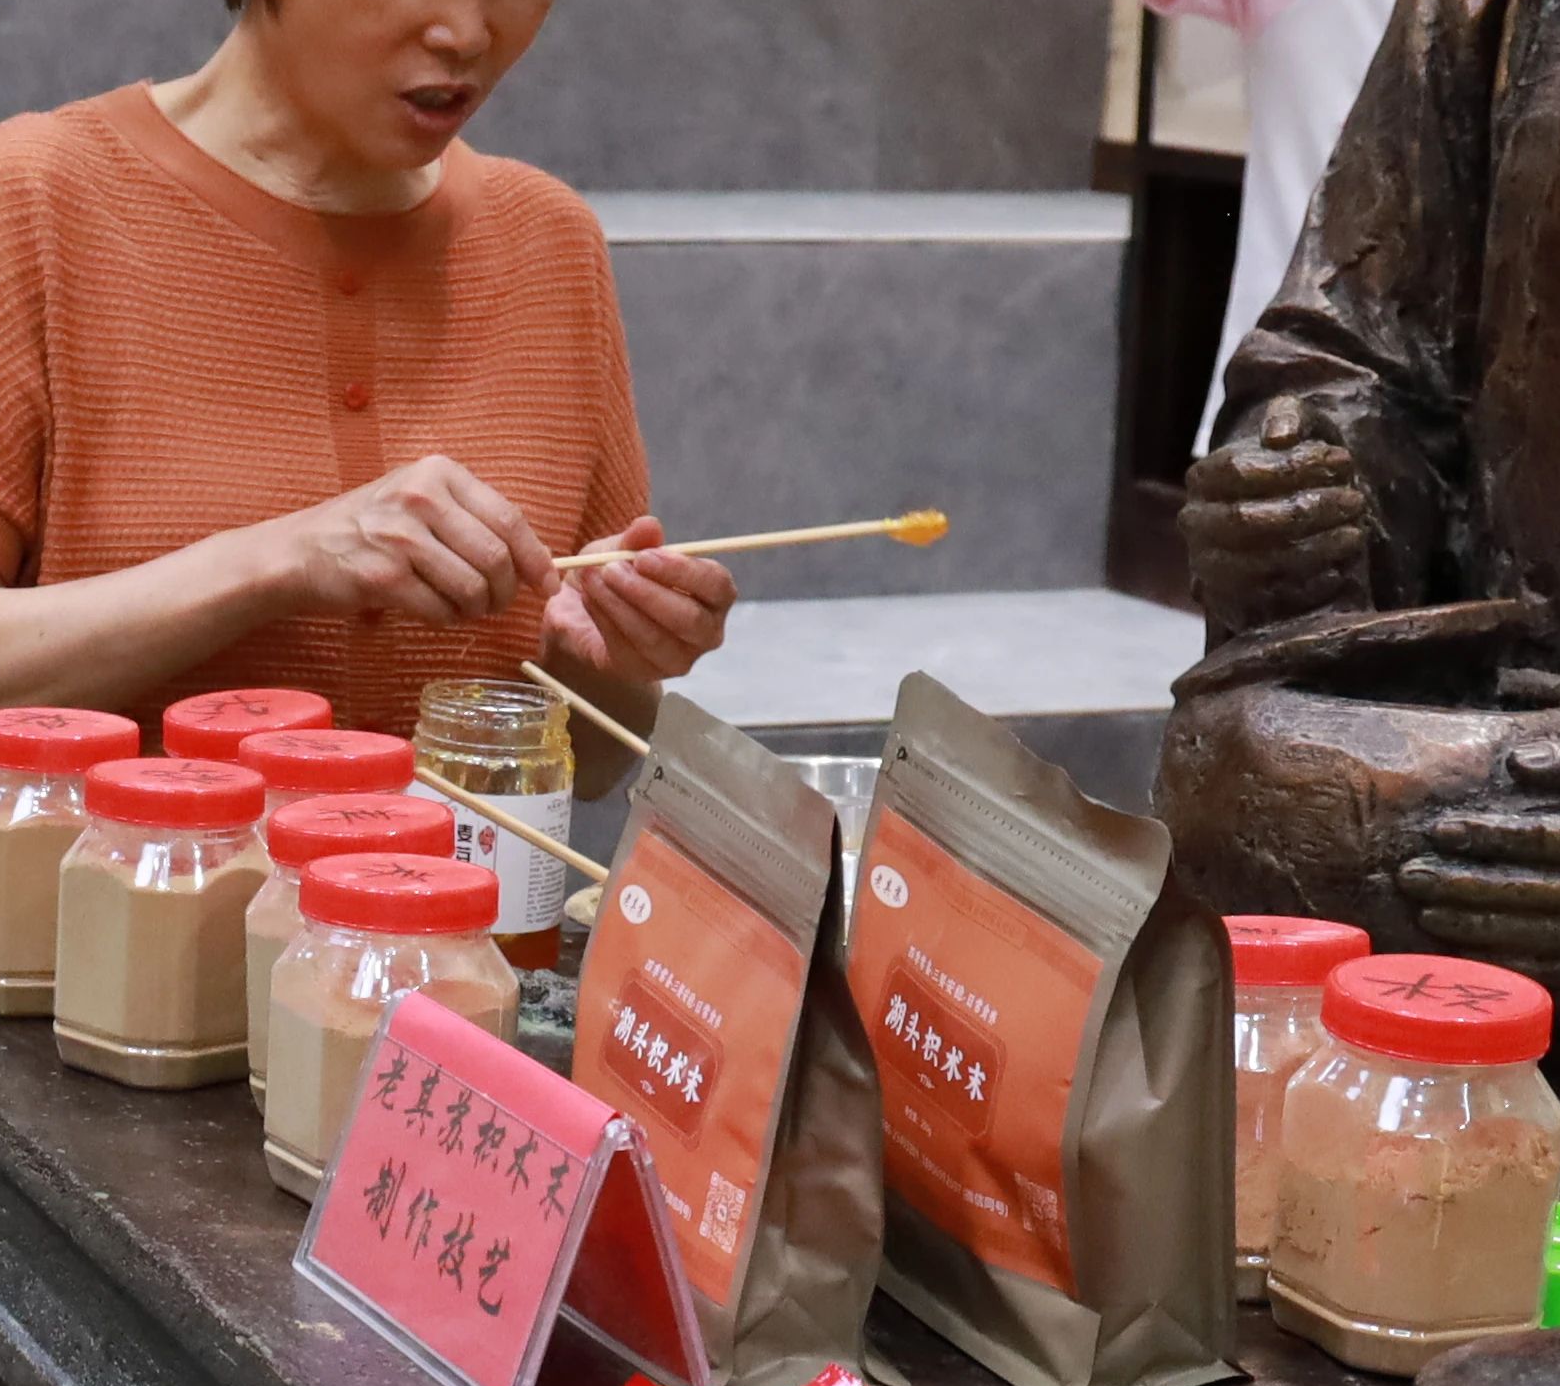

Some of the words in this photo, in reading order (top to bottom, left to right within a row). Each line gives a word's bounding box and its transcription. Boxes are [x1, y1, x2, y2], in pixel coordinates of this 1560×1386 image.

[884, 993, 987, 1102] 湖头枳术末
[362, 1156, 513, 1318] 制作技艺
